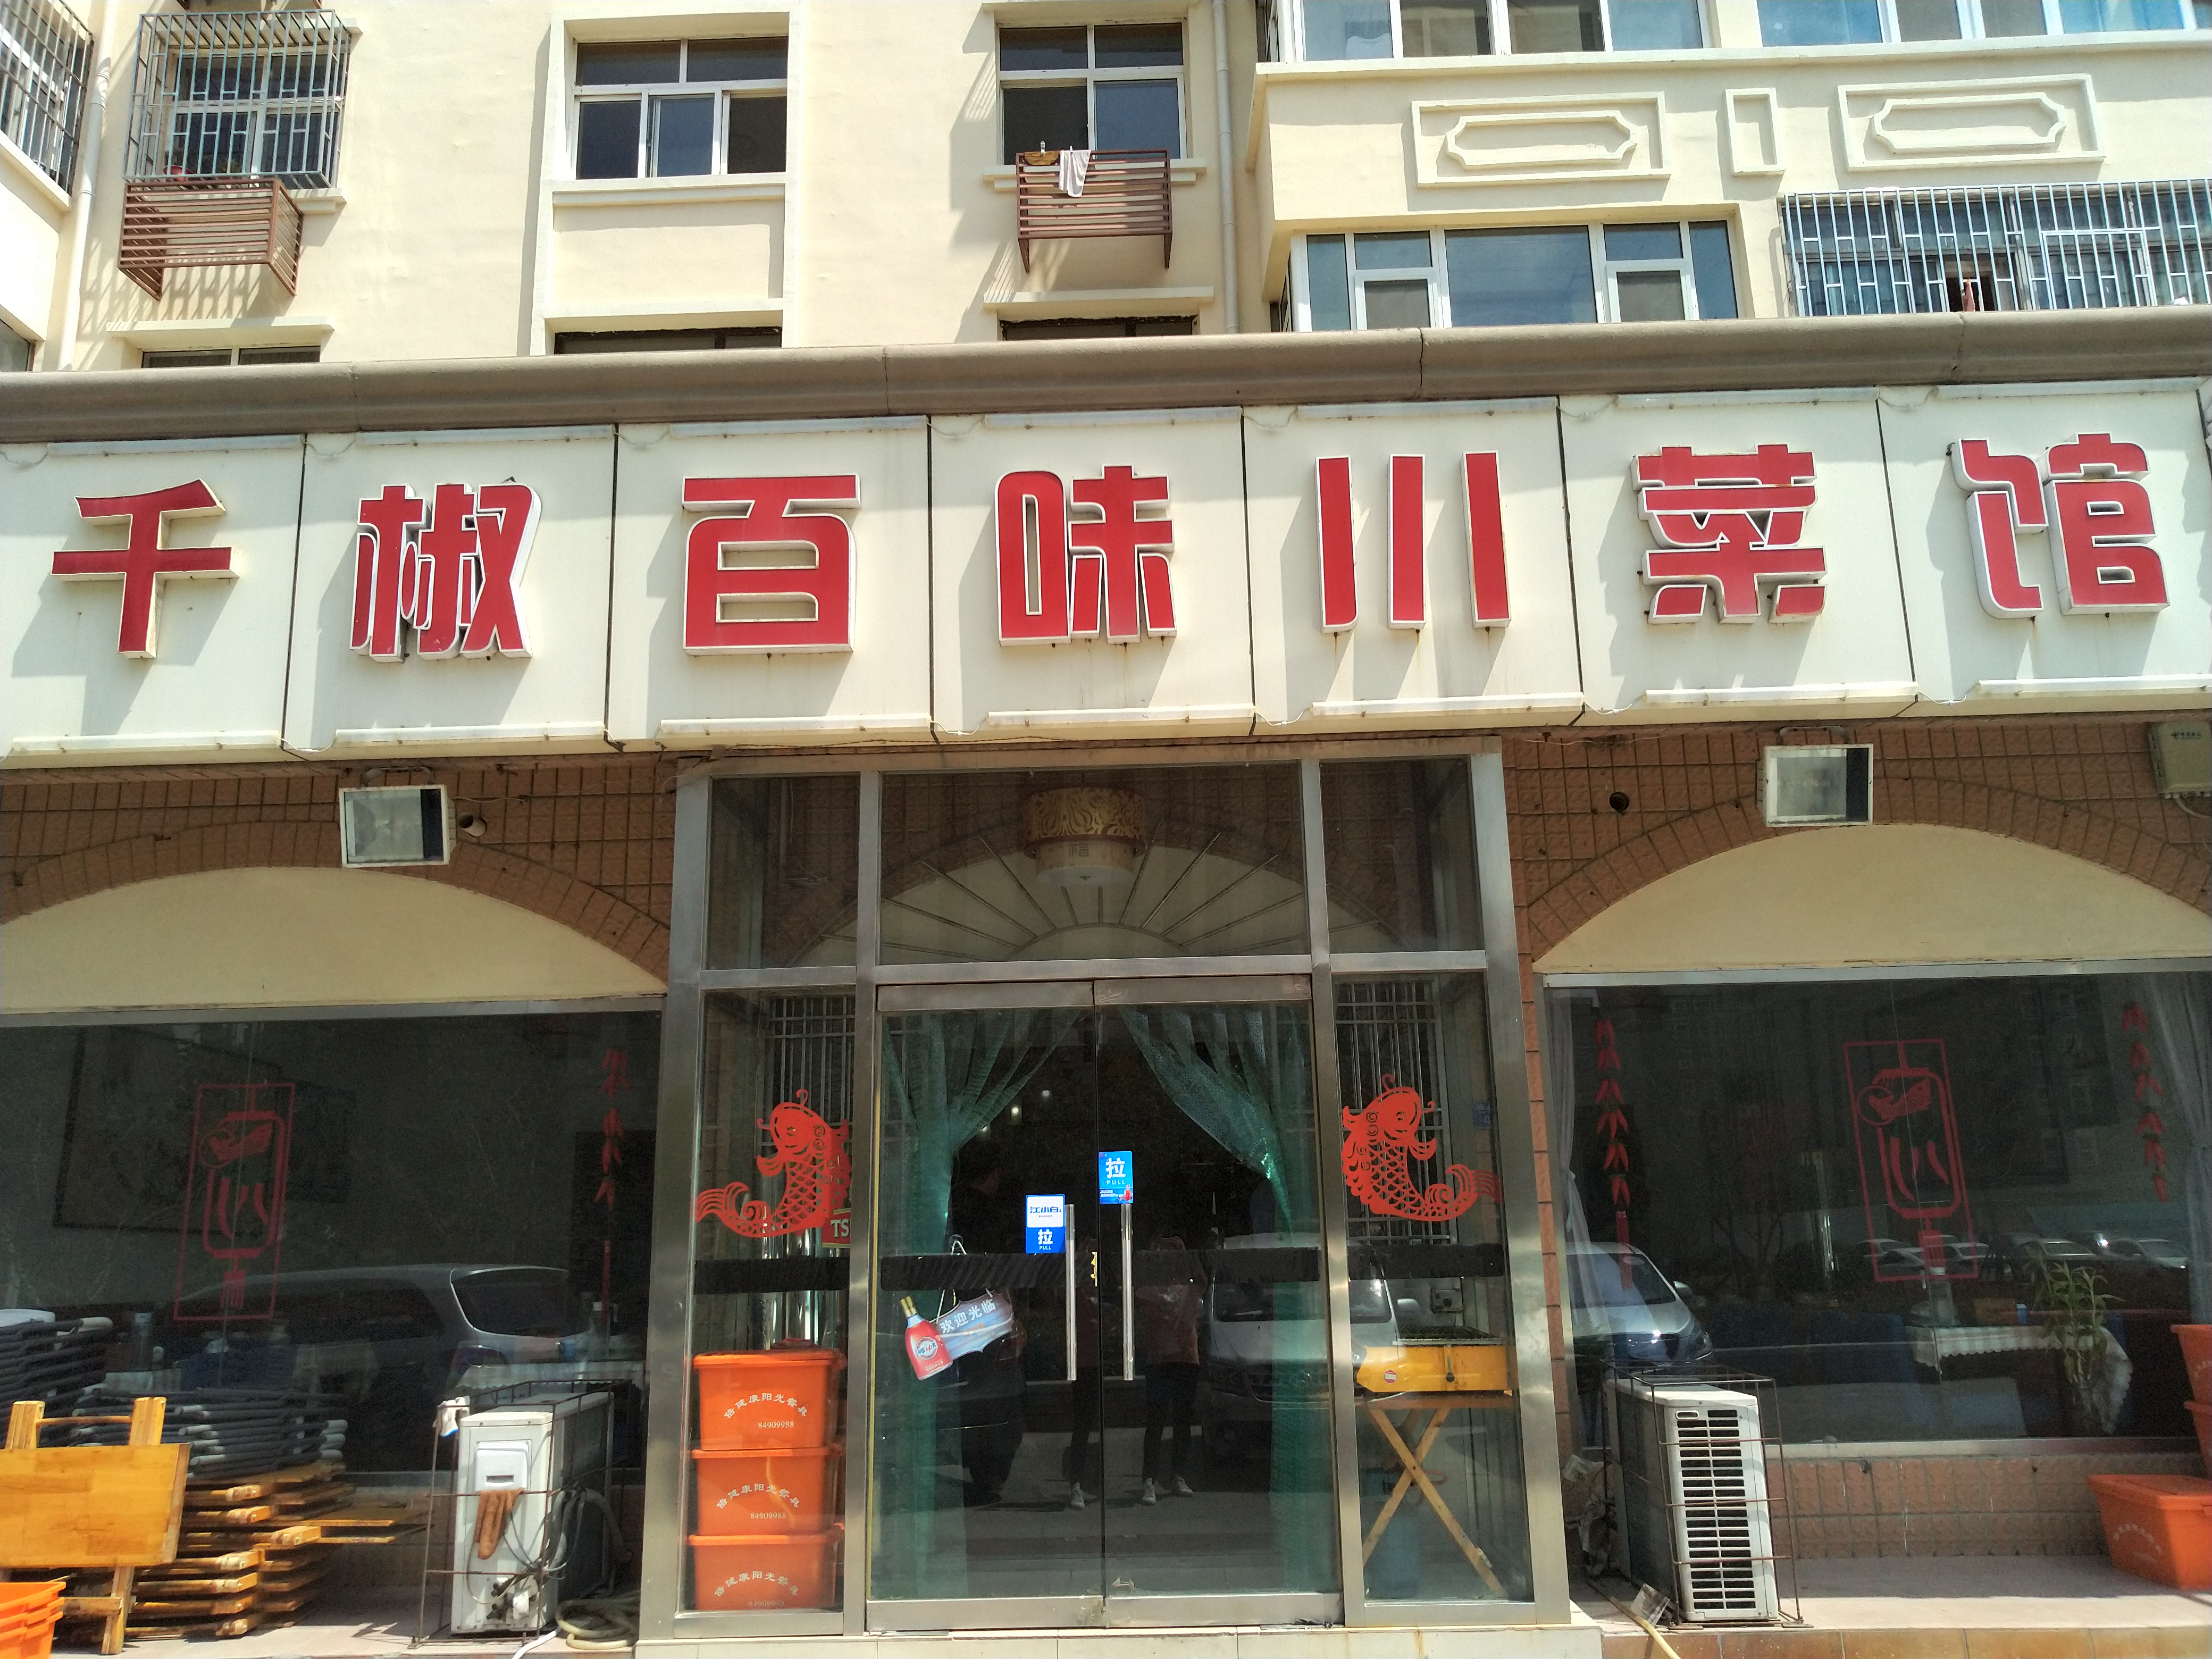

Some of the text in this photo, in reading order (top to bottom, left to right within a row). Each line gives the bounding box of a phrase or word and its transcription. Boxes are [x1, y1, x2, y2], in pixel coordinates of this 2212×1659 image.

[52, 432, 2168, 663] 千椒百味川菜馆
[1105, 1157, 1126, 1178] 拉
[830, 1218, 850, 1238] TS
[1037, 1229, 1053, 1245] 拉
[939, 1298, 996, 1333] 欢迎光临
